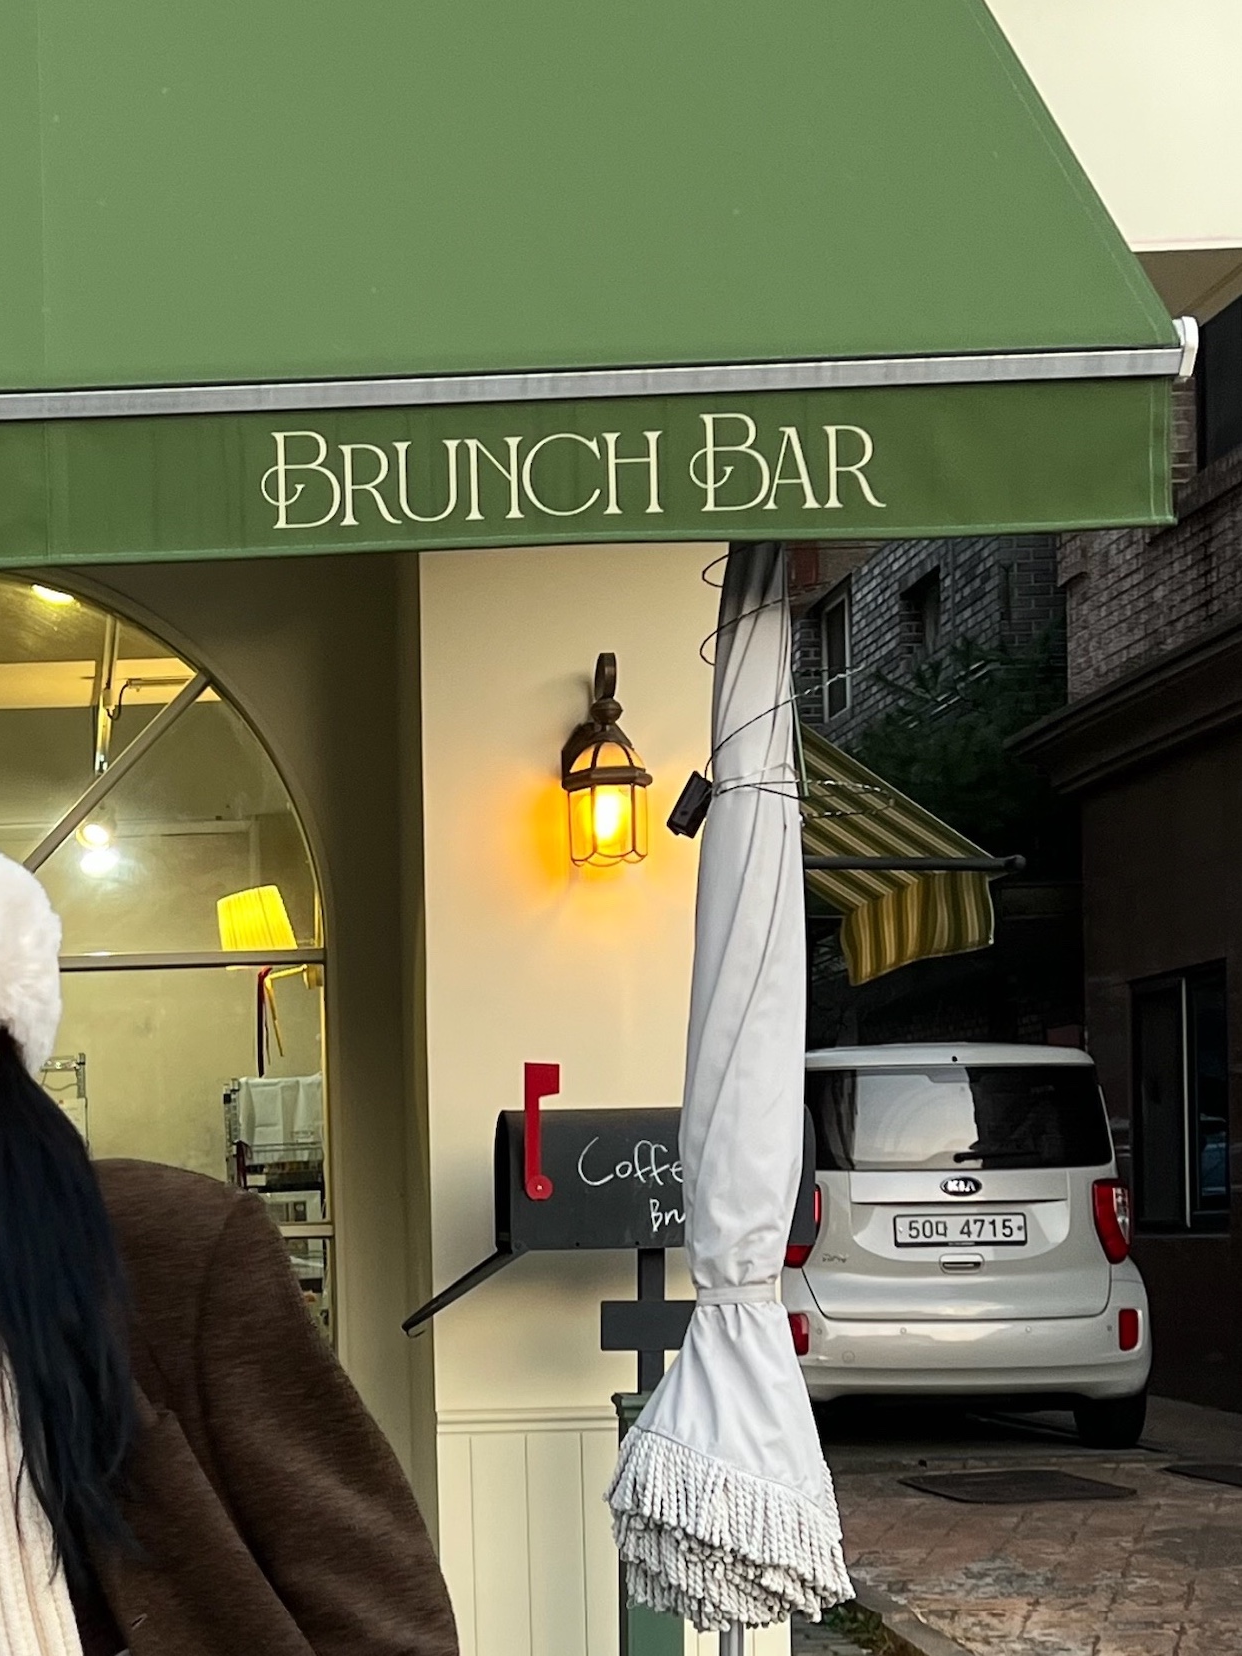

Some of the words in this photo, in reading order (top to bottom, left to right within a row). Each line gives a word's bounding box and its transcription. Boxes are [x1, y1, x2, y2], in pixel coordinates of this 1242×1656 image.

[261, 430, 662, 529] BRUNCH
[689, 412, 886, 512] BAR
[946, 1180, 976, 1192] KIA
[959, 1218, 1013, 1238] 4715
